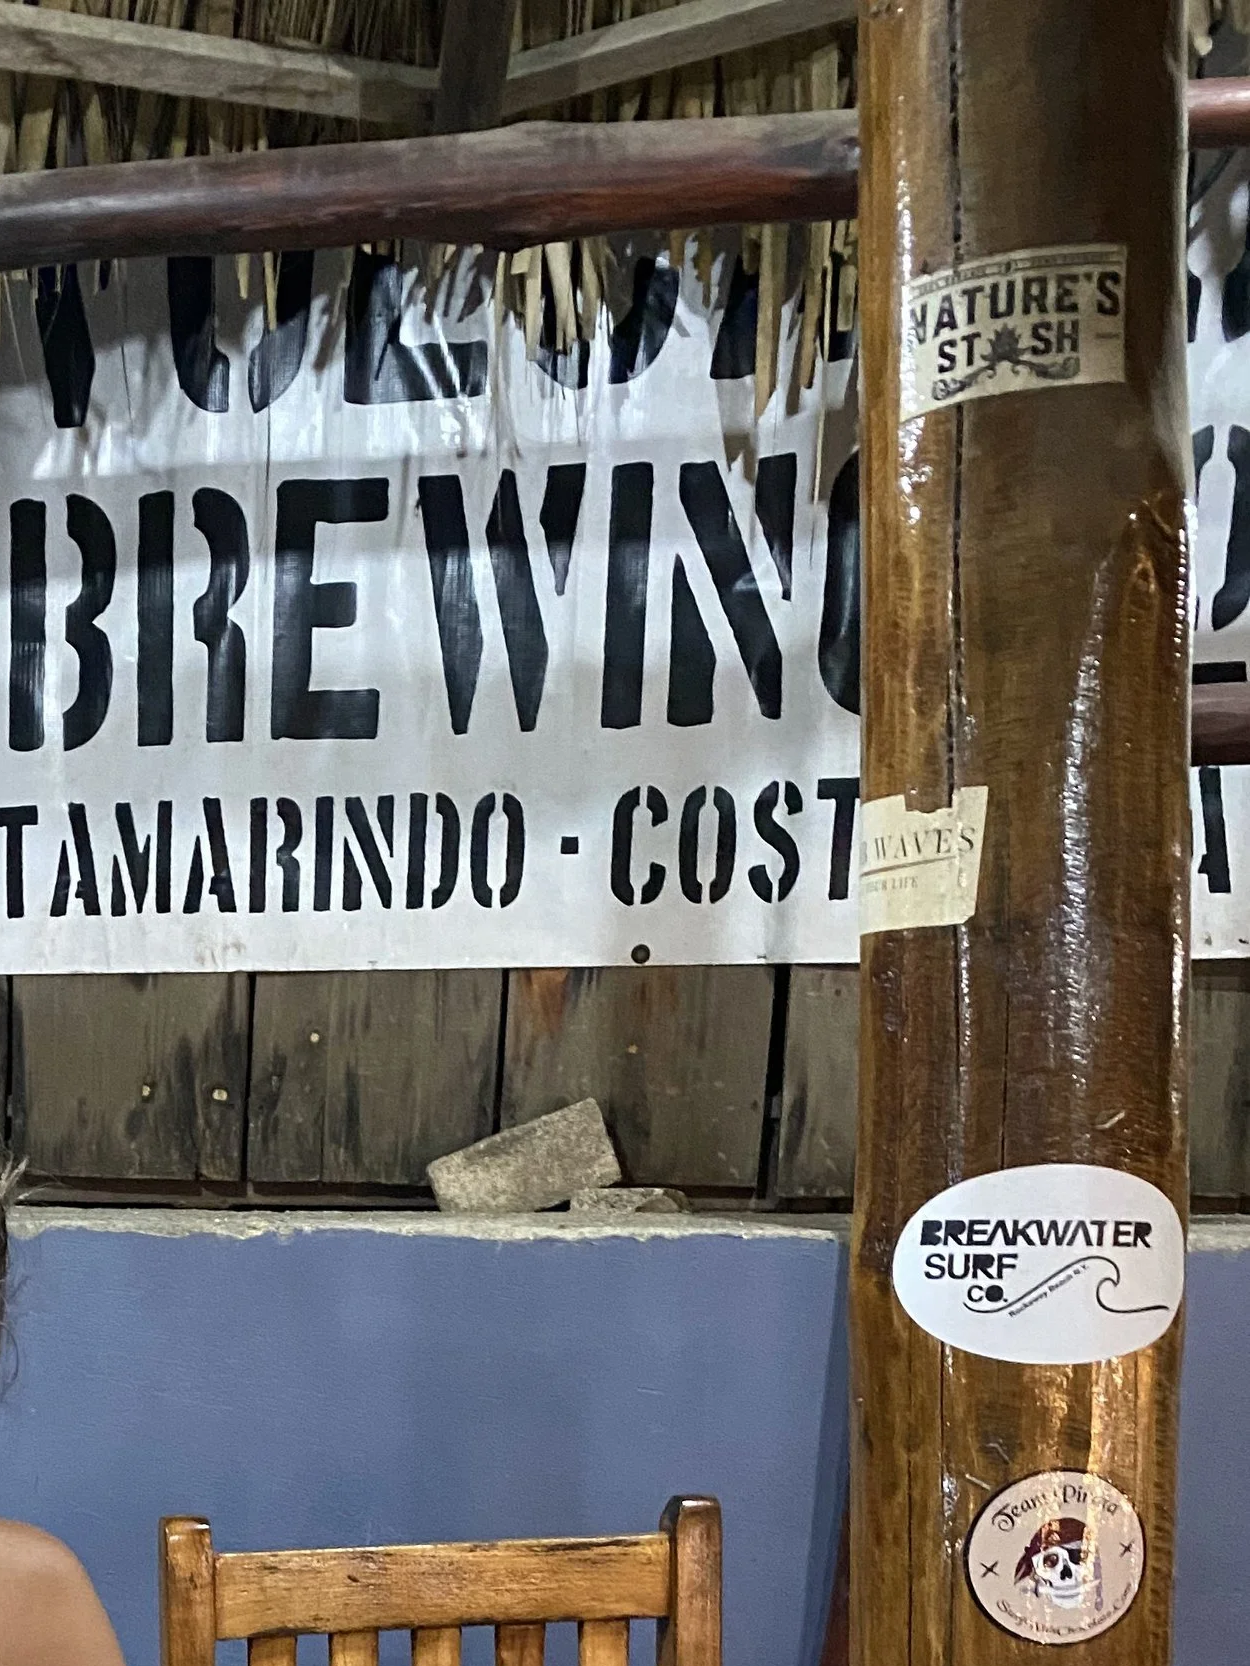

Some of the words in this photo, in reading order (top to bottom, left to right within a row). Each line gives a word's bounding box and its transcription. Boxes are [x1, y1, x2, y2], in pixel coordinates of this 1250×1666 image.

[910, 271, 1121, 345] NATURE'S
[920, 1219, 1152, 1248] BREAKWATER
[924, 1252, 1018, 1280] SURF
[966, 1284, 1009, 1303] CO.
